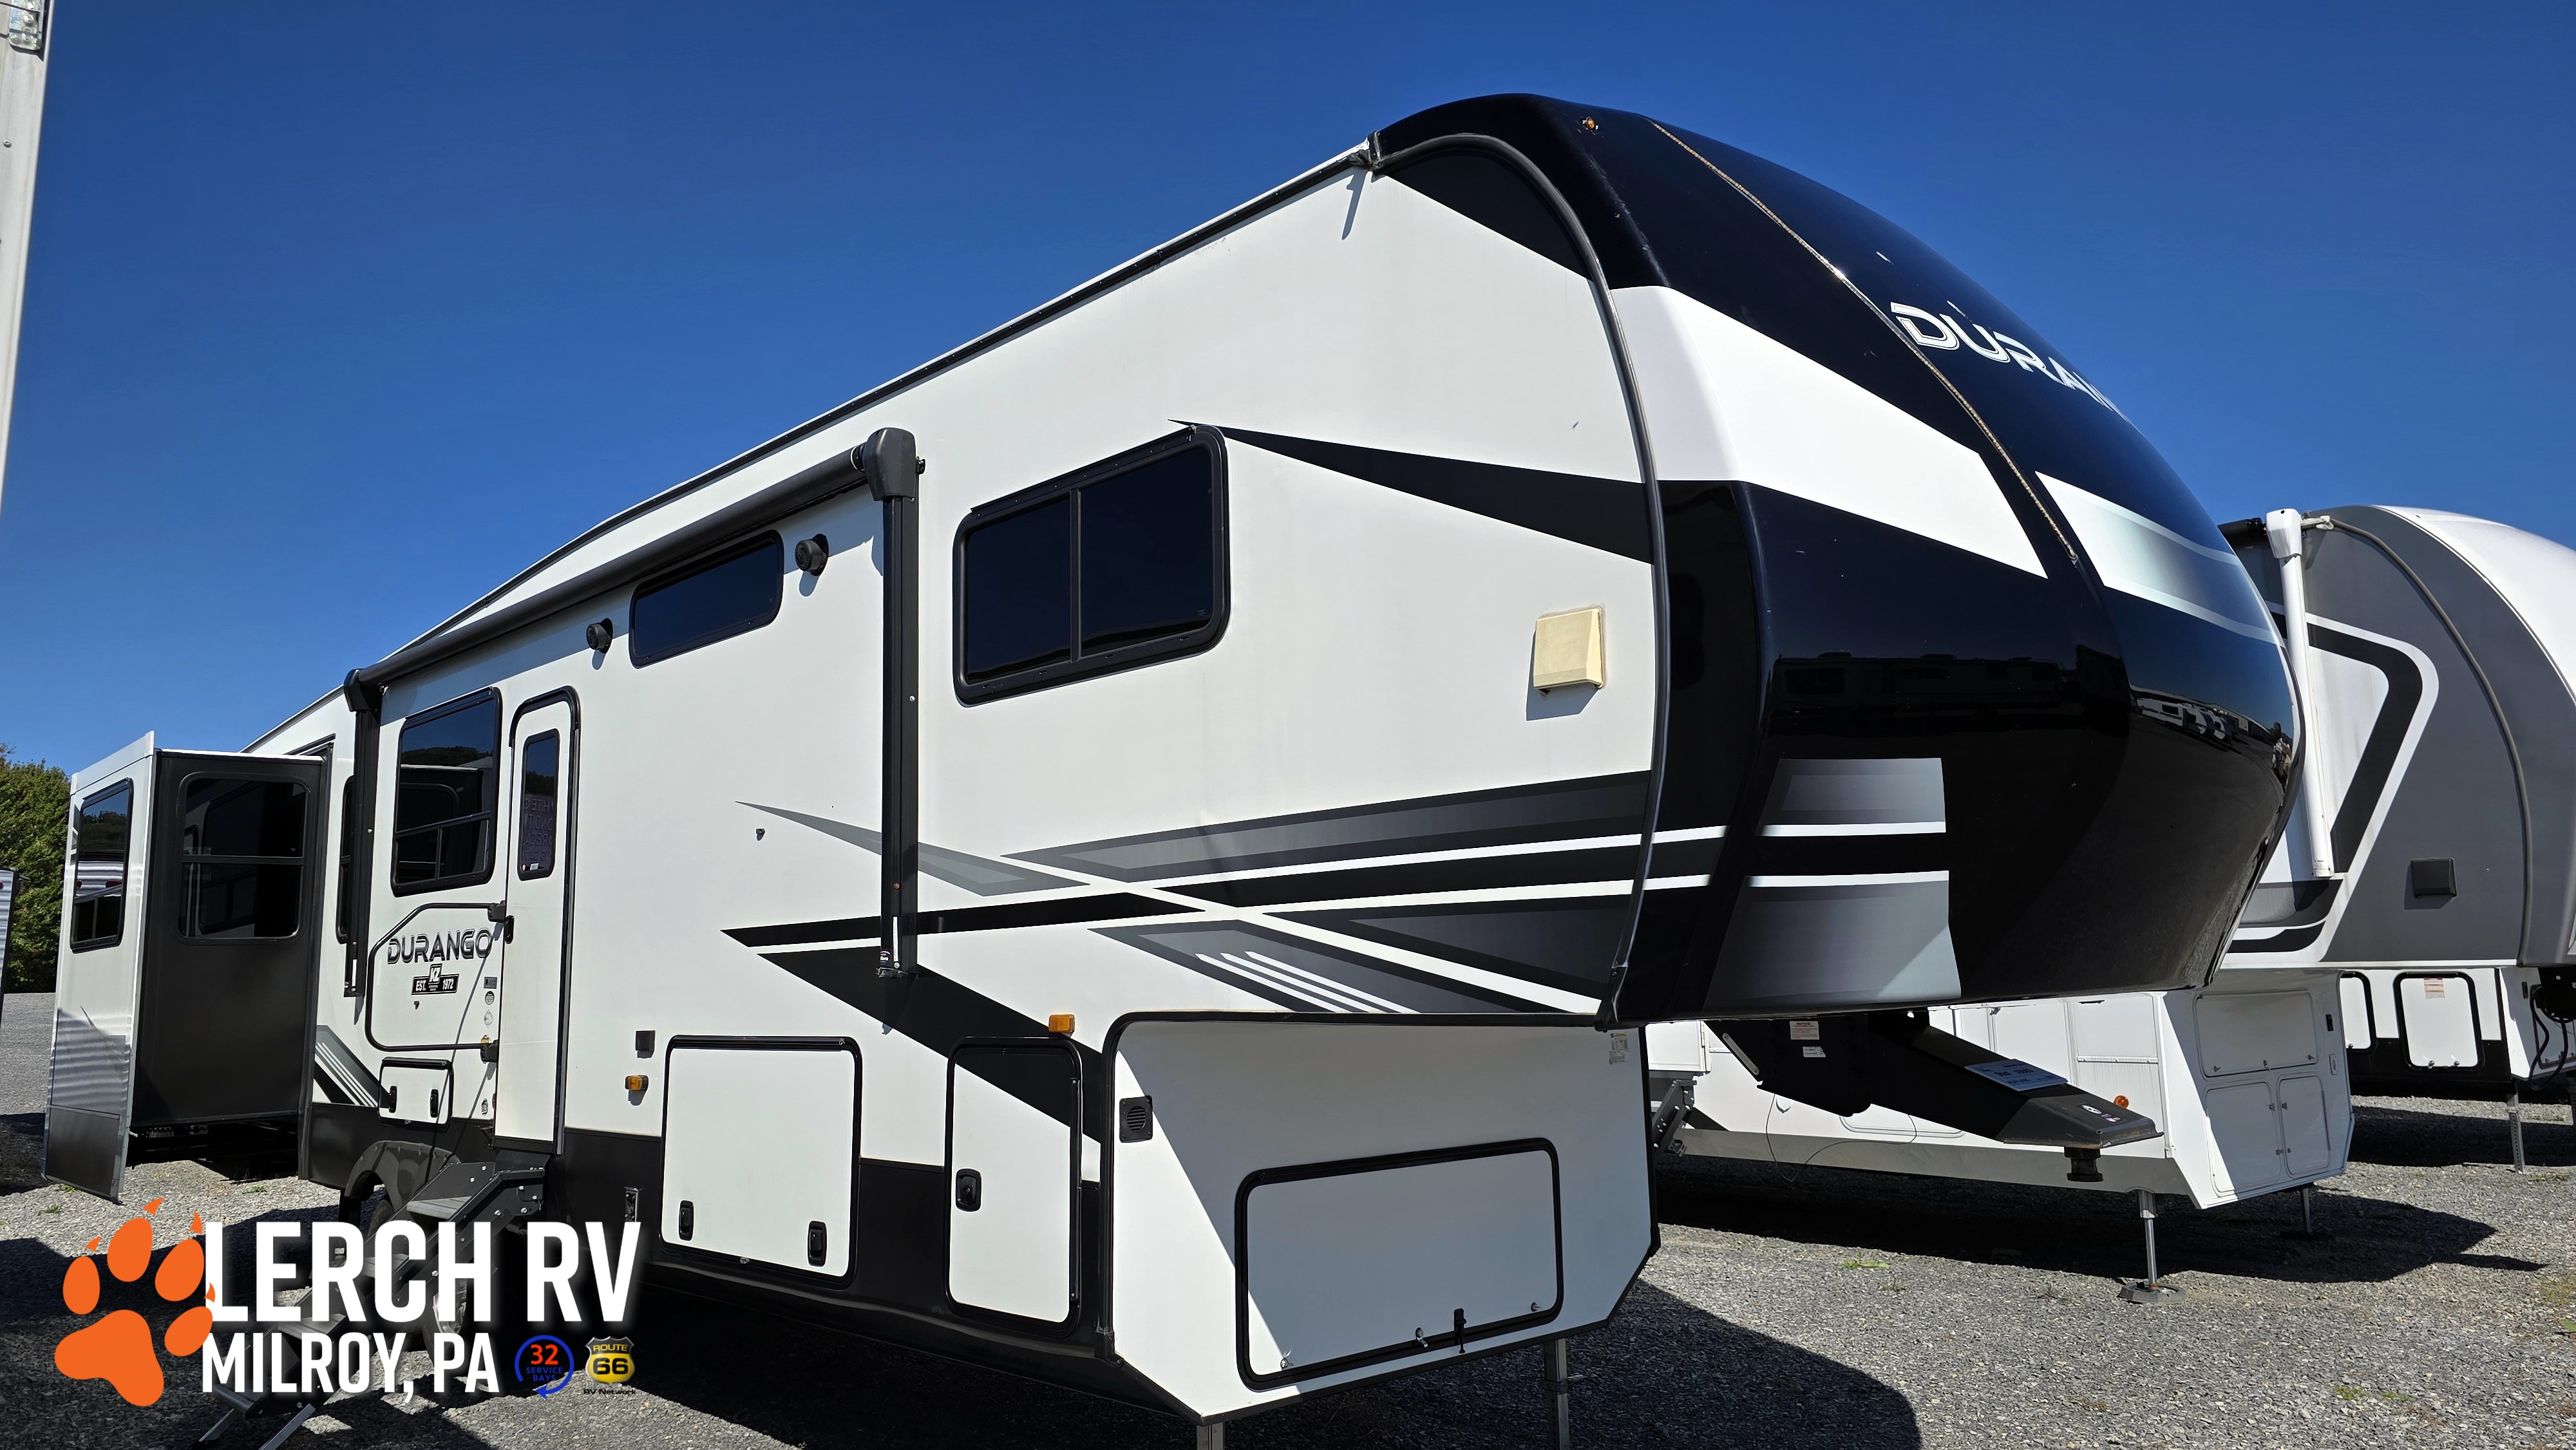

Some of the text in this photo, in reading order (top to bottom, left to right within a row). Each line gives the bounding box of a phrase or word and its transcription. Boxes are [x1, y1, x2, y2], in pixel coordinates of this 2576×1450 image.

[1891, 302, 2145, 438] DURAN
[388, 928, 492, 965] DURANGO
[415, 980, 426, 992] EST.
[442, 978, 454, 990] 1972
[430, 967, 440, 982] KZ
